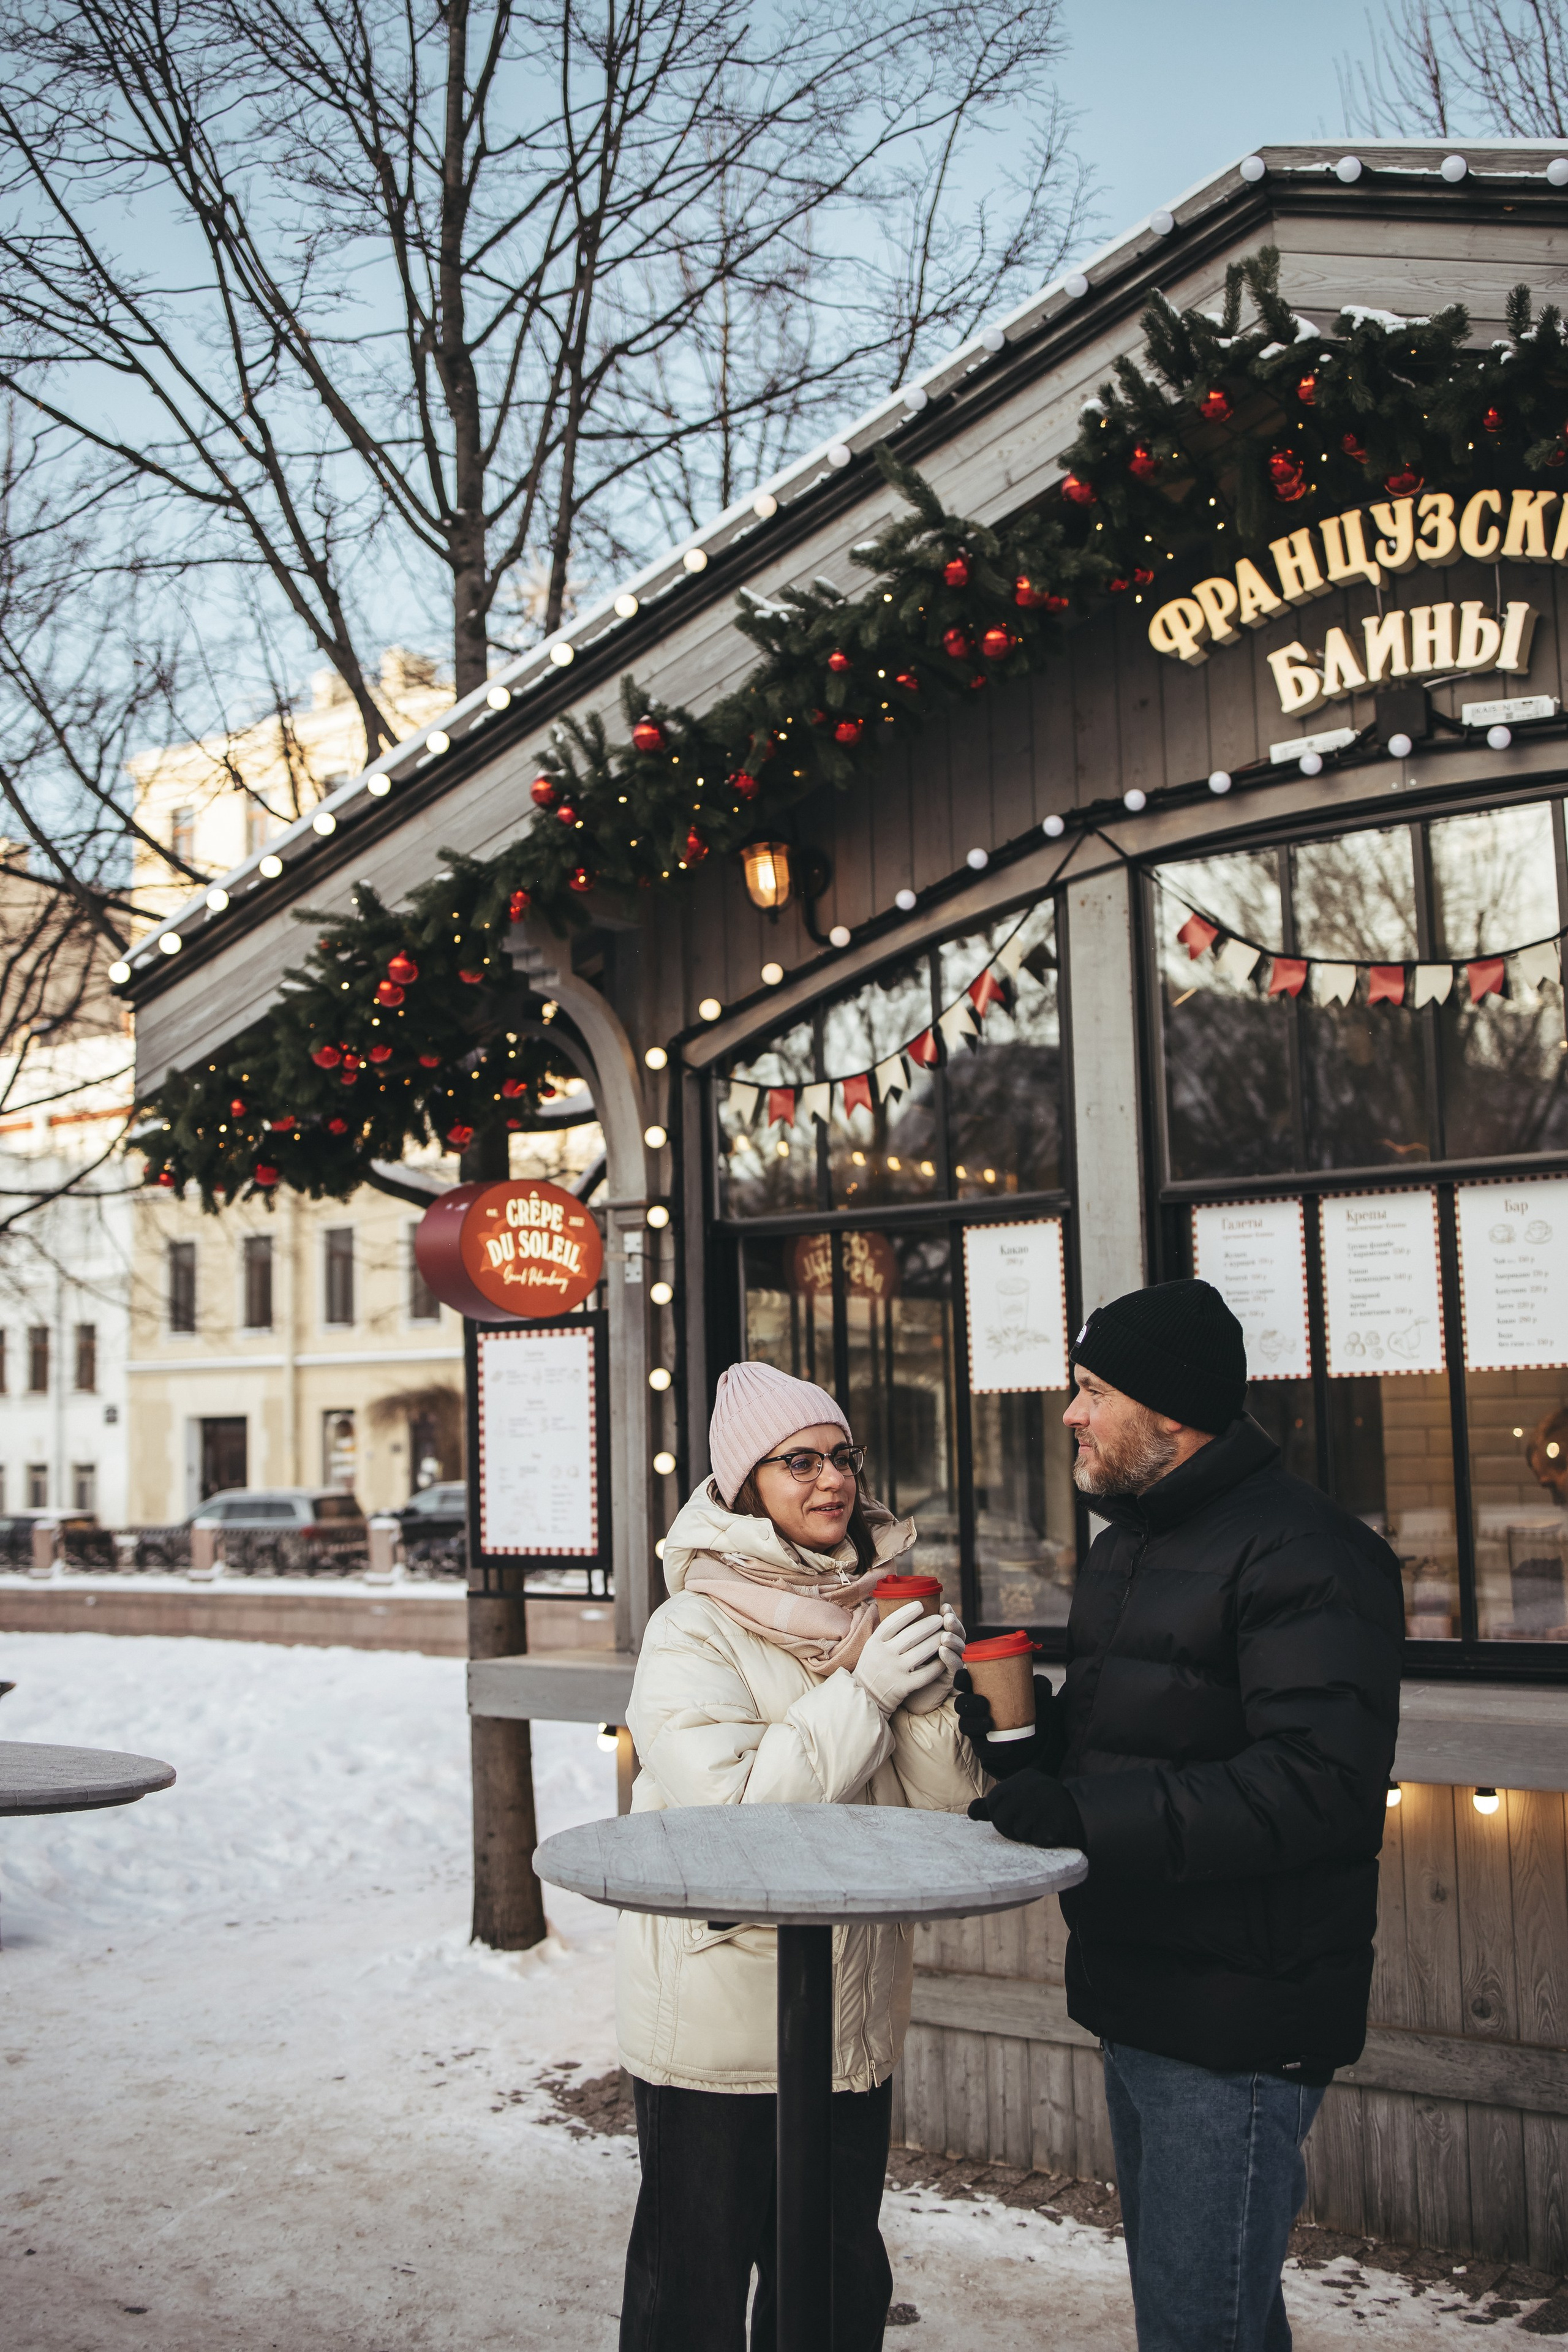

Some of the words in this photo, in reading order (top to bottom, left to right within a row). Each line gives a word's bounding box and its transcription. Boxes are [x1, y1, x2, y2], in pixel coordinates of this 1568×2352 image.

[1267, 601, 1529, 714] БЛИНЫ
[506, 1191, 564, 1233] CRÊPE
[1504, 1198, 1529, 1215] Бар
[1221, 1217, 1264, 1231] Галеты
[1346, 1209, 1387, 1224] Крепы
[486, 1231, 516, 1268] DU
[518, 1229, 581, 1273] SOLEIL
[1000, 1245, 1029, 1255] Какао
